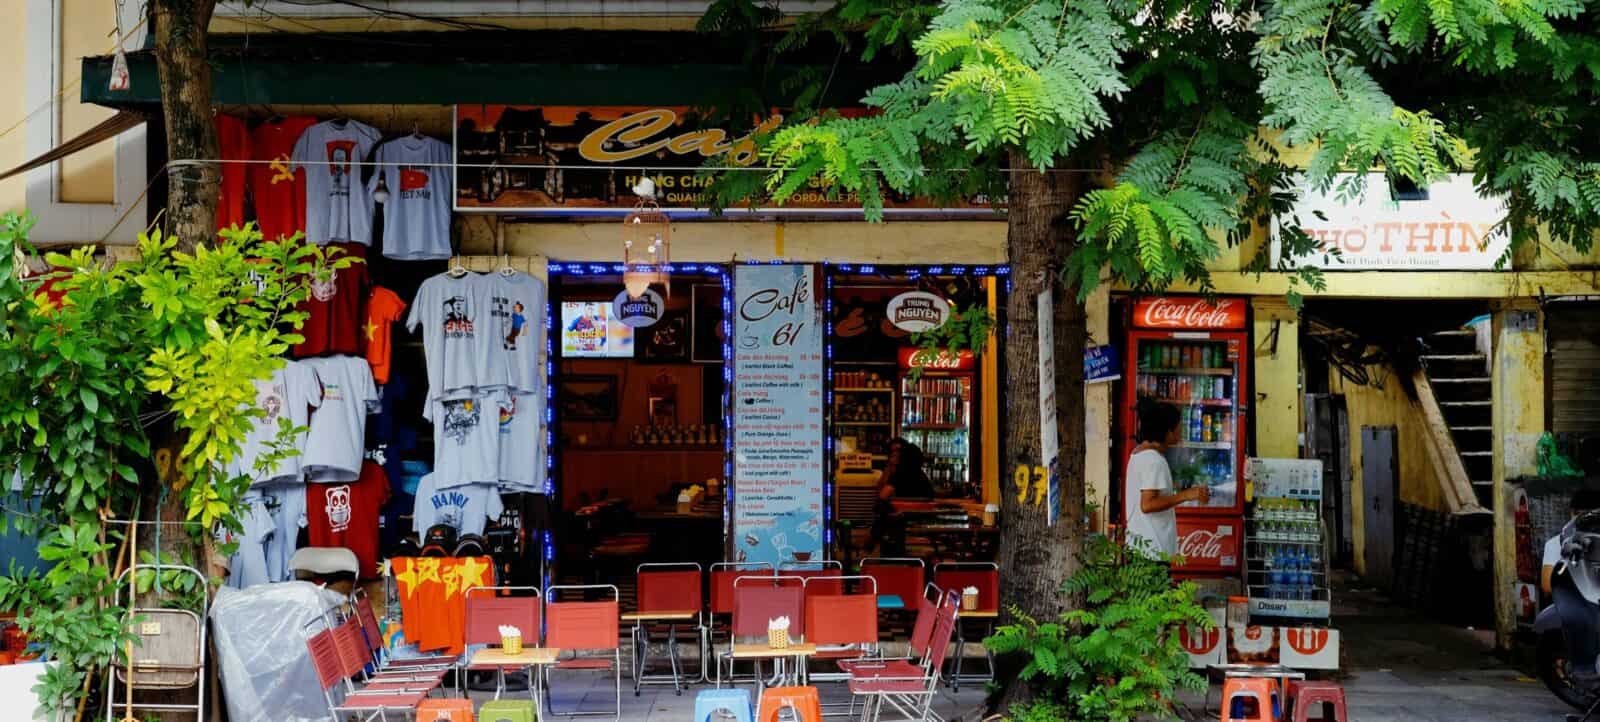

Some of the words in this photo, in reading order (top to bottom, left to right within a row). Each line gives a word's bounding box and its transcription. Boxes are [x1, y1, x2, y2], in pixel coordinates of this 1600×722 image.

[740, 275, 809, 321] Café
[1145, 298, 1232, 327] Coca-Cola
[773, 322, 805, 346] 61
[432, 491, 469, 510] HANOI
